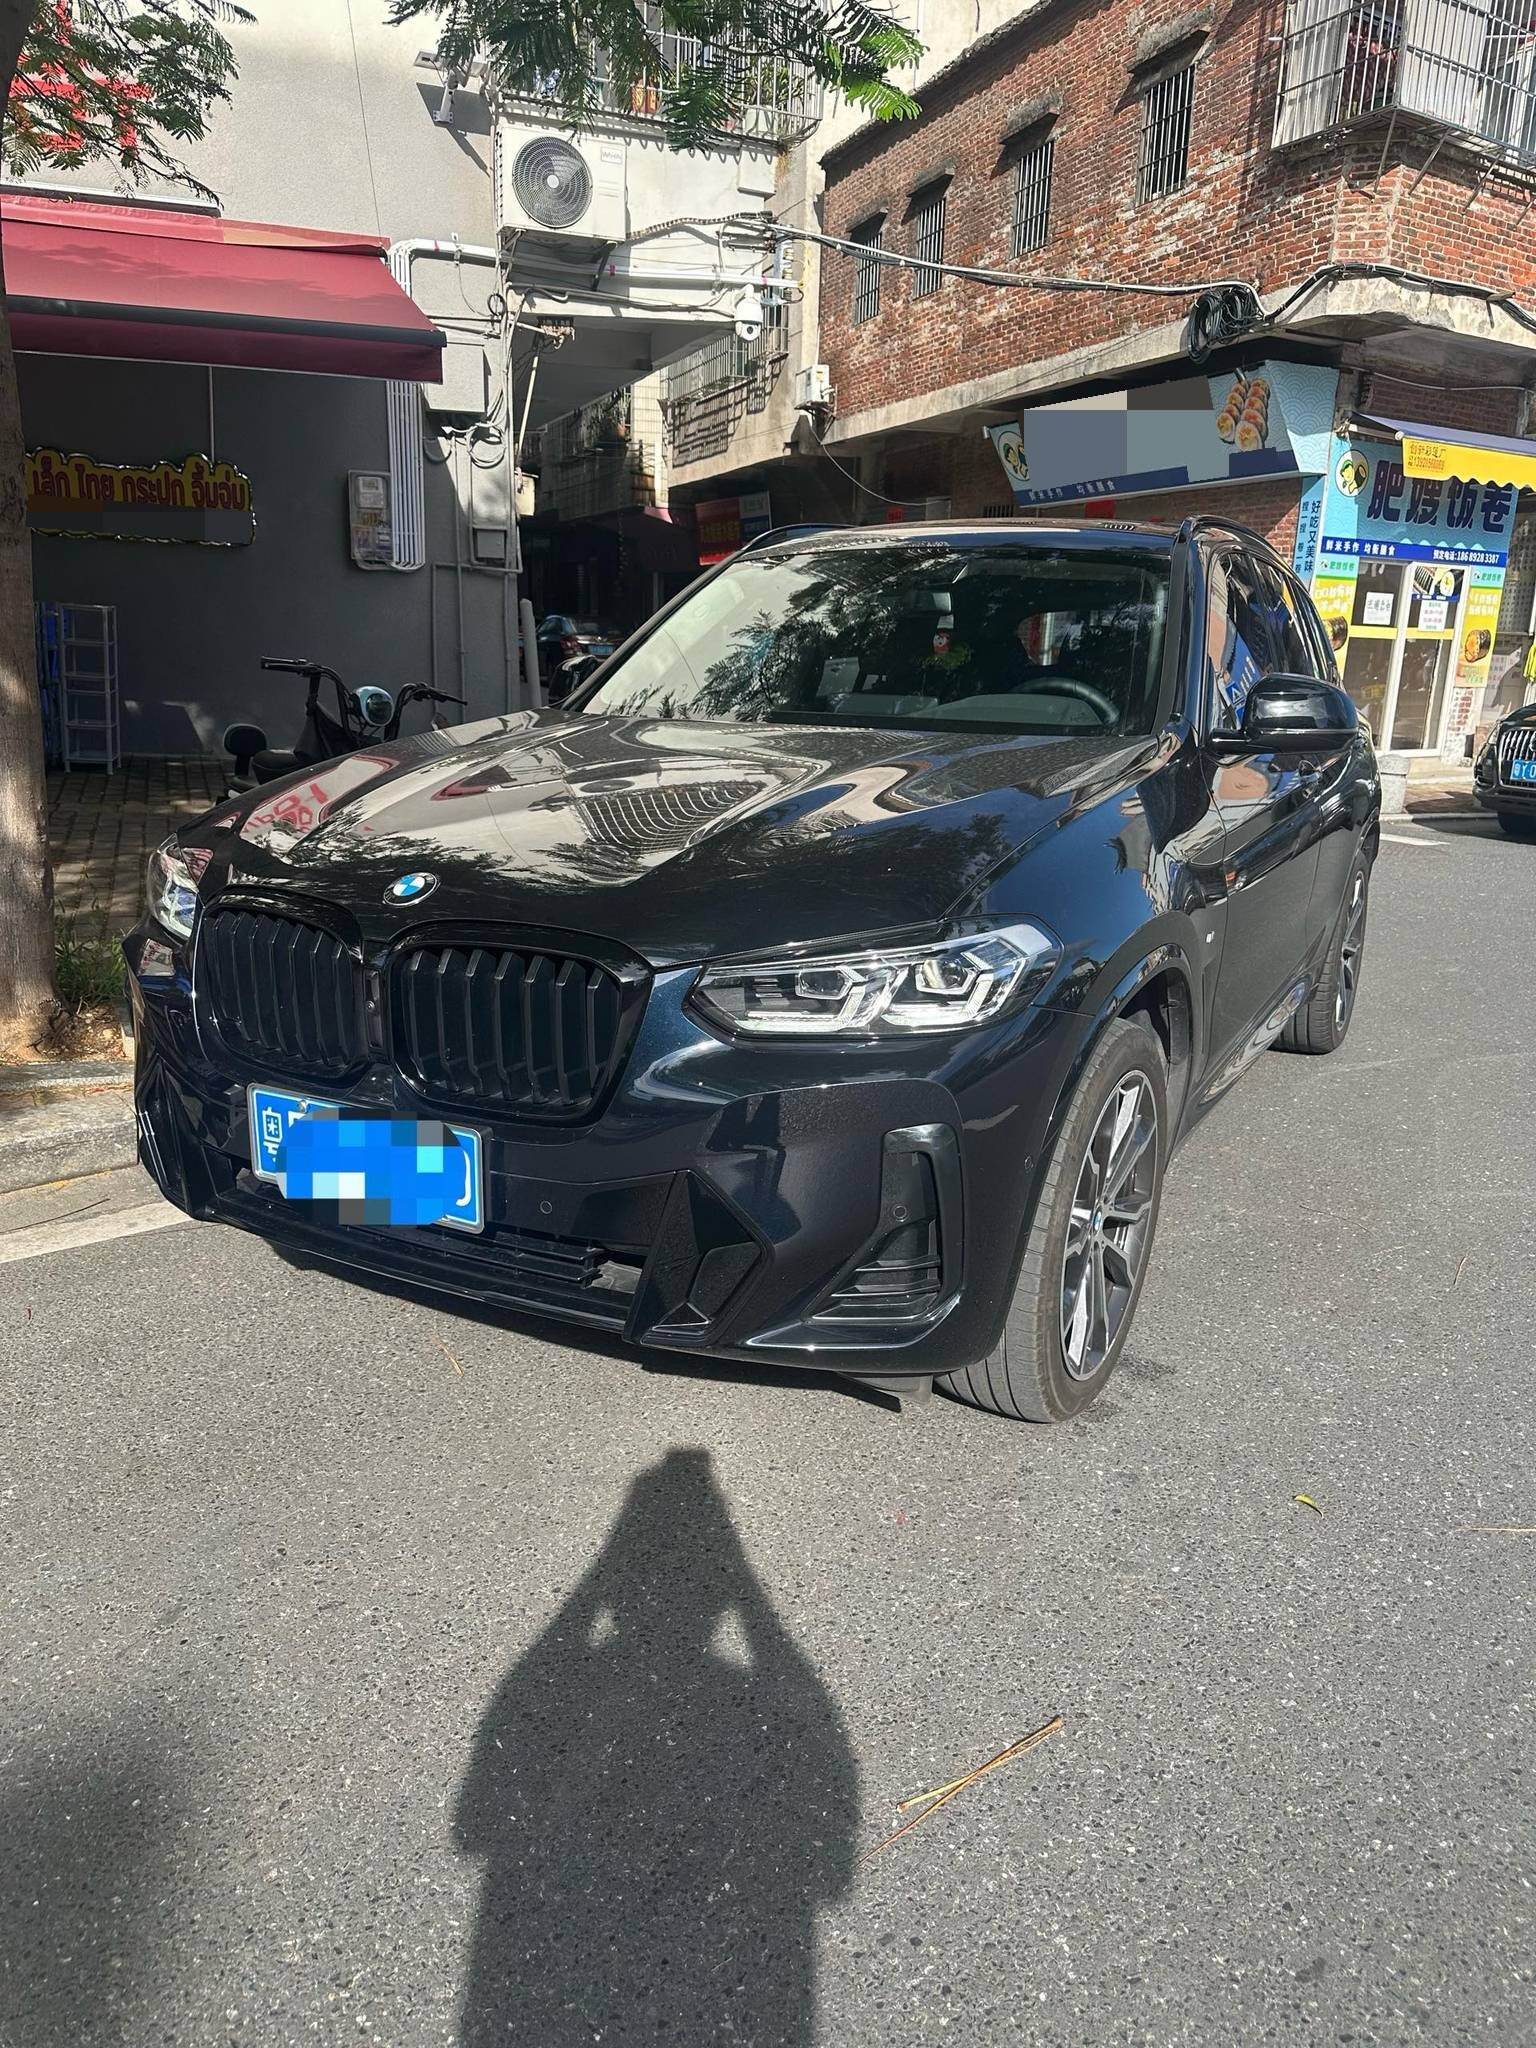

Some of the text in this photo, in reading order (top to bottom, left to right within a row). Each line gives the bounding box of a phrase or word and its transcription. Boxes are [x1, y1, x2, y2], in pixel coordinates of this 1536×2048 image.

[1367, 459, 1512, 534] 肥嫂饭卷
[1304, 500, 1321, 573] 好吃又美味
[1326, 540, 1359, 552] 鲜米手作
[1364, 543, 1395, 557] 均衡膳食
